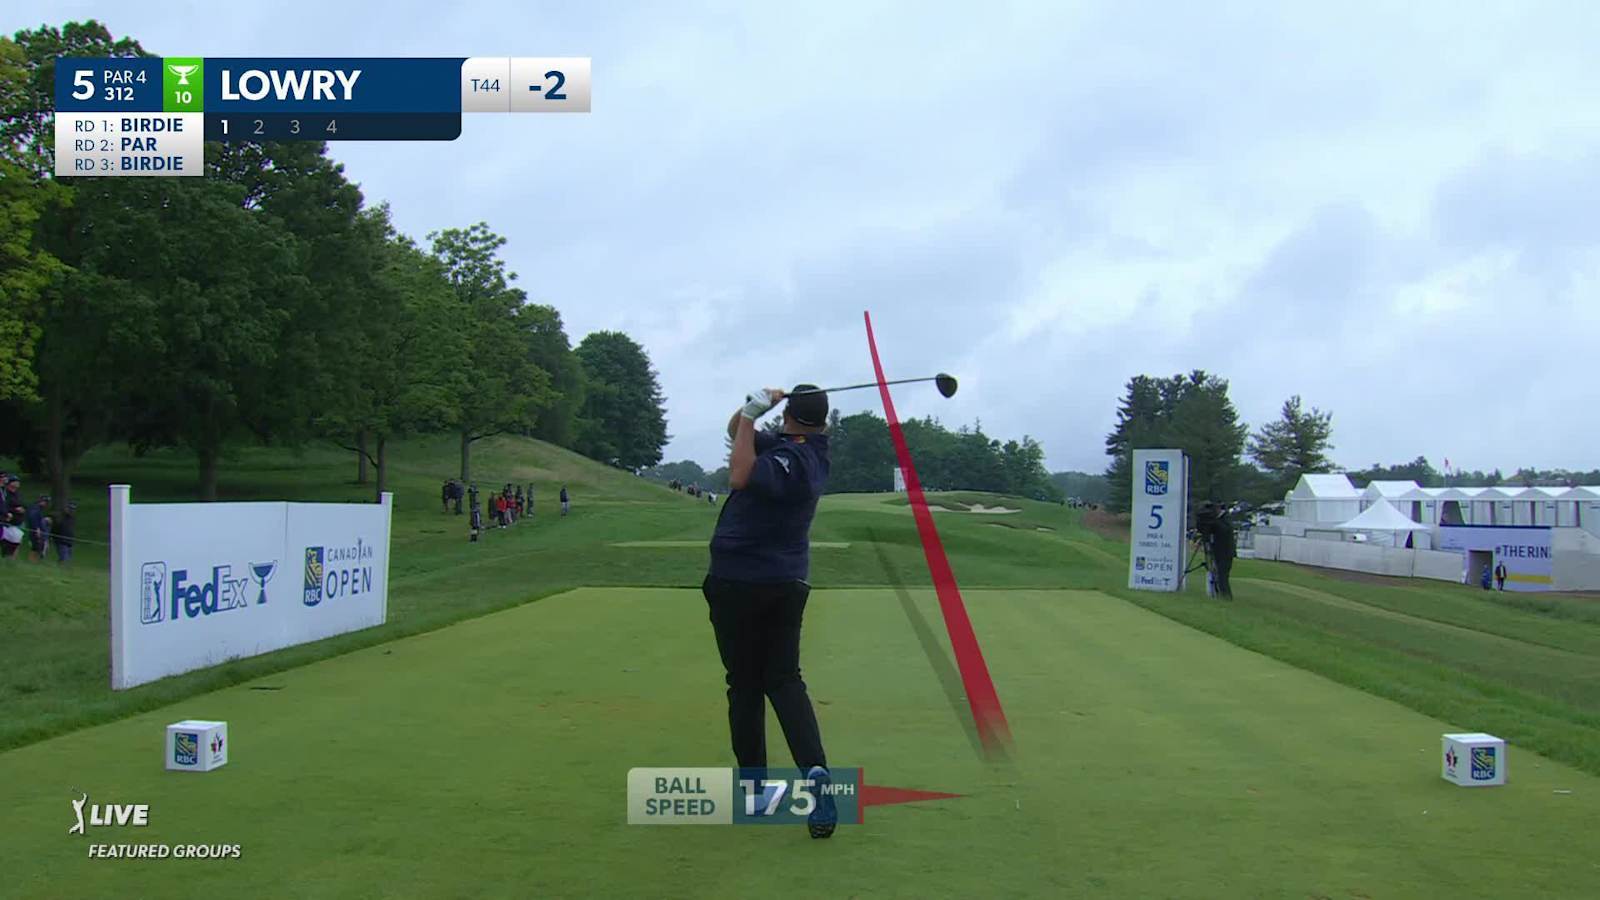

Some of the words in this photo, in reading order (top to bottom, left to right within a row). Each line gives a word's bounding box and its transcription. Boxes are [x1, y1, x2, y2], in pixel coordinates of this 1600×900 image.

[1146, 485, 1166, 494] RBC
[1148, 505, 1163, 530] 5
[328, 539, 373, 562] CANADIAN
[1146, 563, 1173, 572] OPEN
[326, 566, 372, 599] OPEN
[171, 564, 249, 620] FedEx
[304, 588, 321, 603] RBC
[176, 755, 196, 764] RBC
[1473, 770, 1493, 778] RBC
